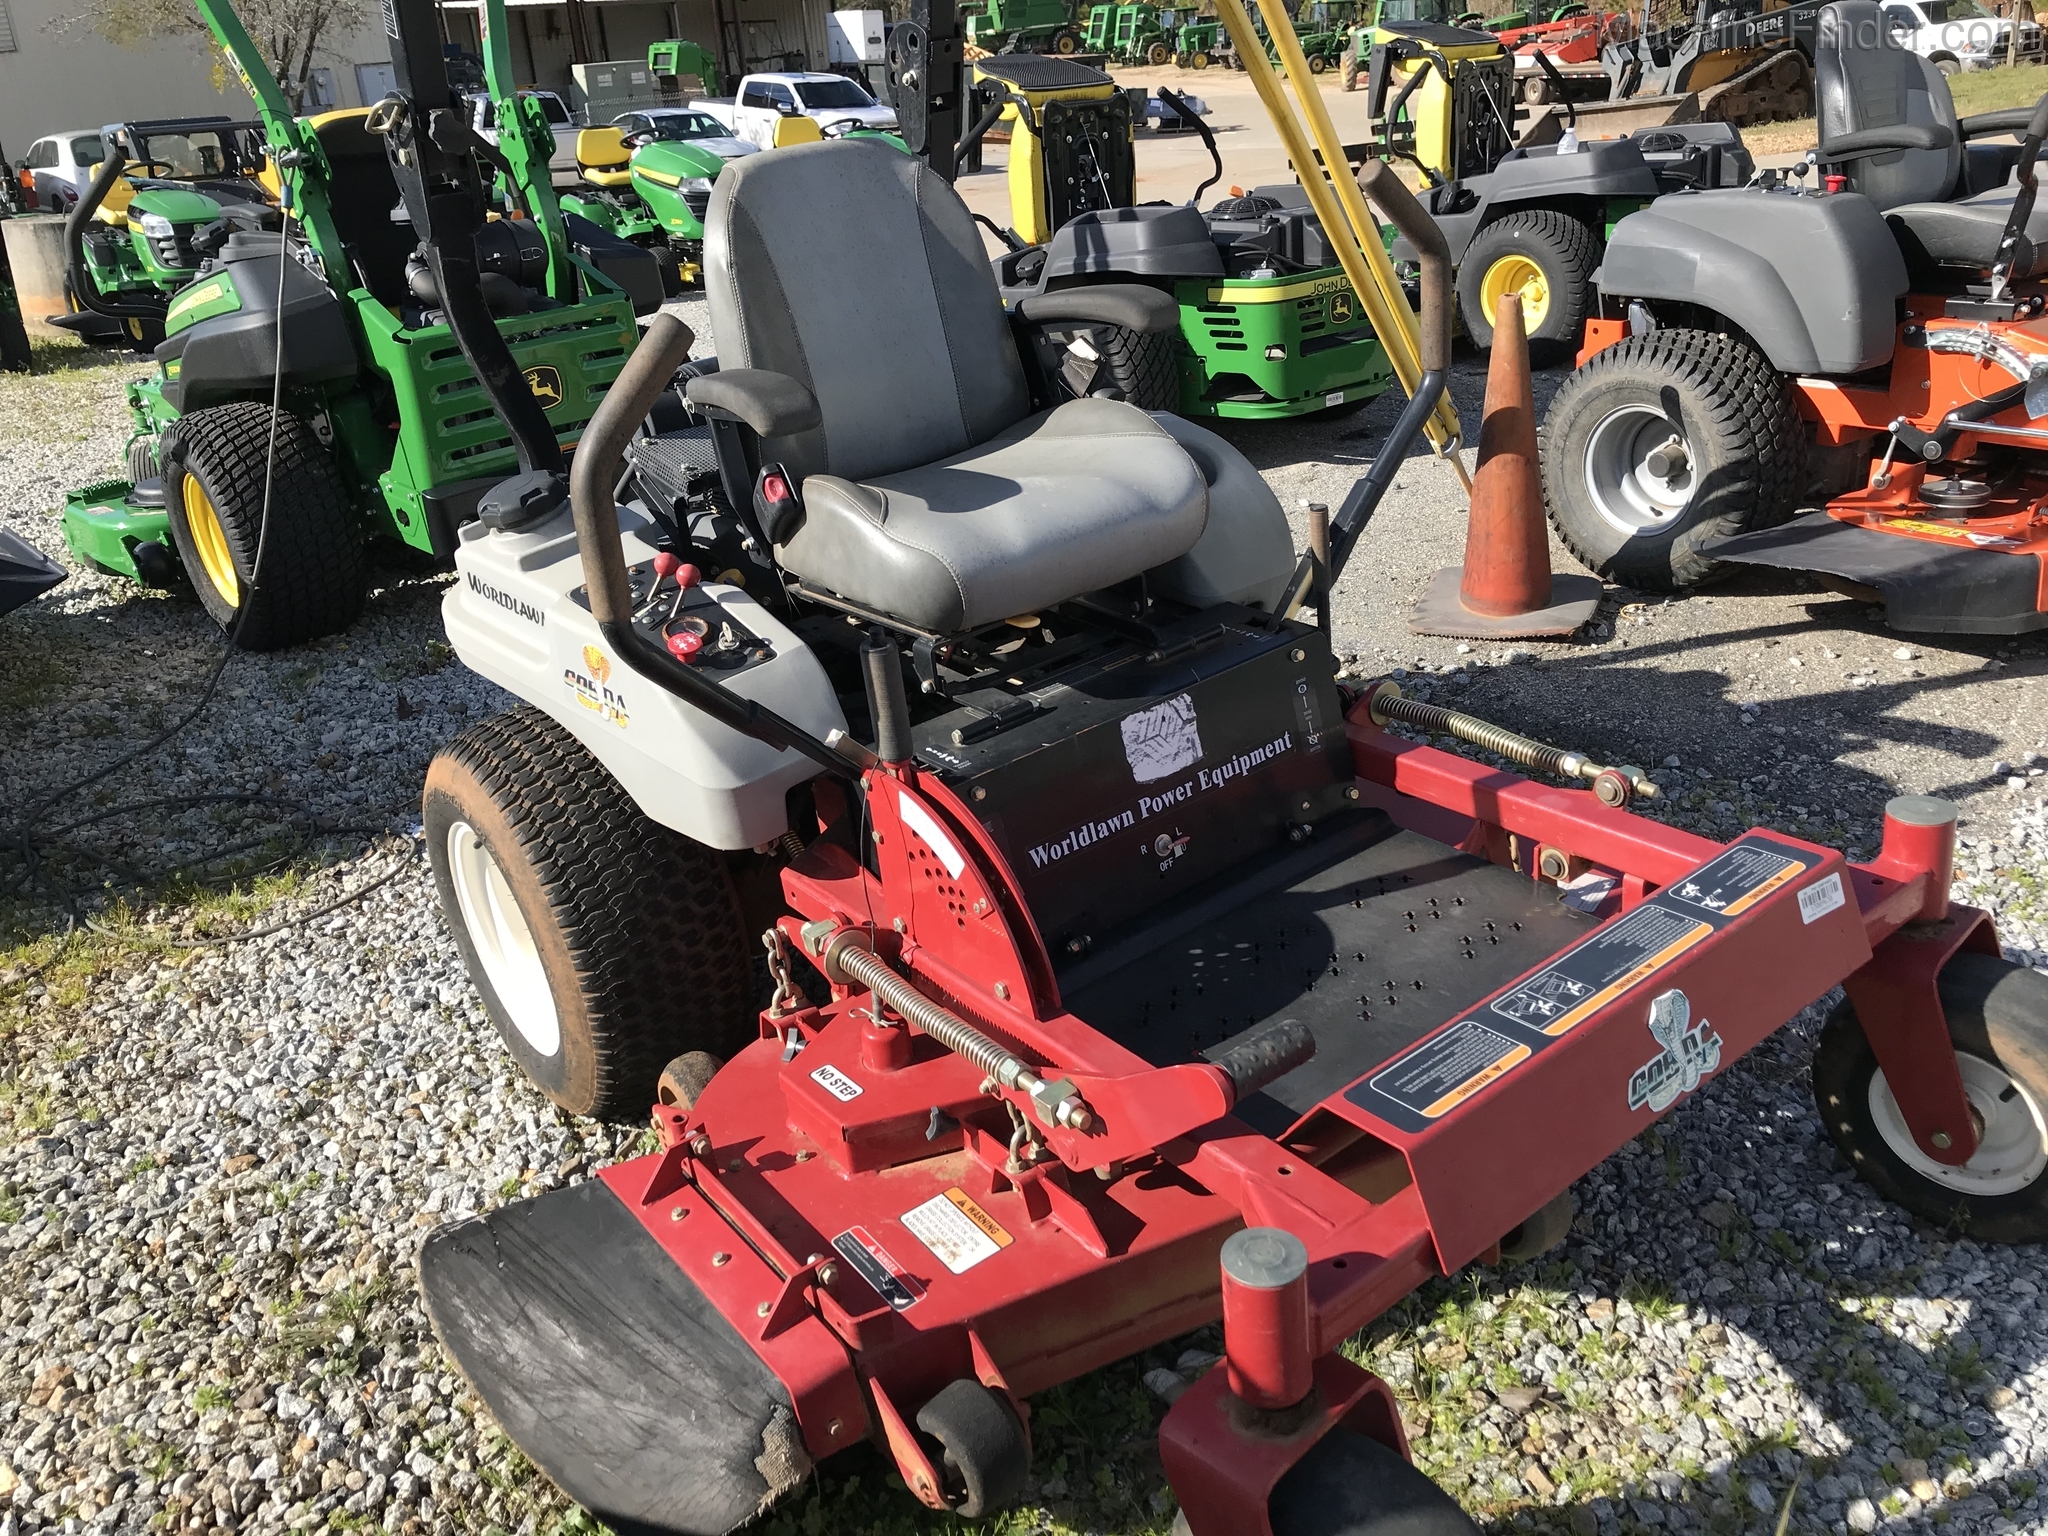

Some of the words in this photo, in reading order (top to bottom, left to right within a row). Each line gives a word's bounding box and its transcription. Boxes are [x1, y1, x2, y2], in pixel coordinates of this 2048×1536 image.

[1746, 16, 1784, 37] DEERE
[1311, 278, 1338, 296] JOHN
[1028, 809, 1135, 870] Worldlawn
[1138, 780, 1193, 820] Power
[1197, 731, 1293, 791] Equipment
[1140, 844, 1148, 855] R
[1159, 858, 1174, 872] OFF
[1747, 881, 1775, 901] WARNING
[1614, 968, 1645, 992] WARNING
[815, 1067, 833, 1081] NO
[829, 1076, 858, 1098] STEP
[1456, 1072, 1491, 1097] WARNING
[966, 1205, 999, 1235] WARNING
[875, 1250, 898, 1272] DANGER
